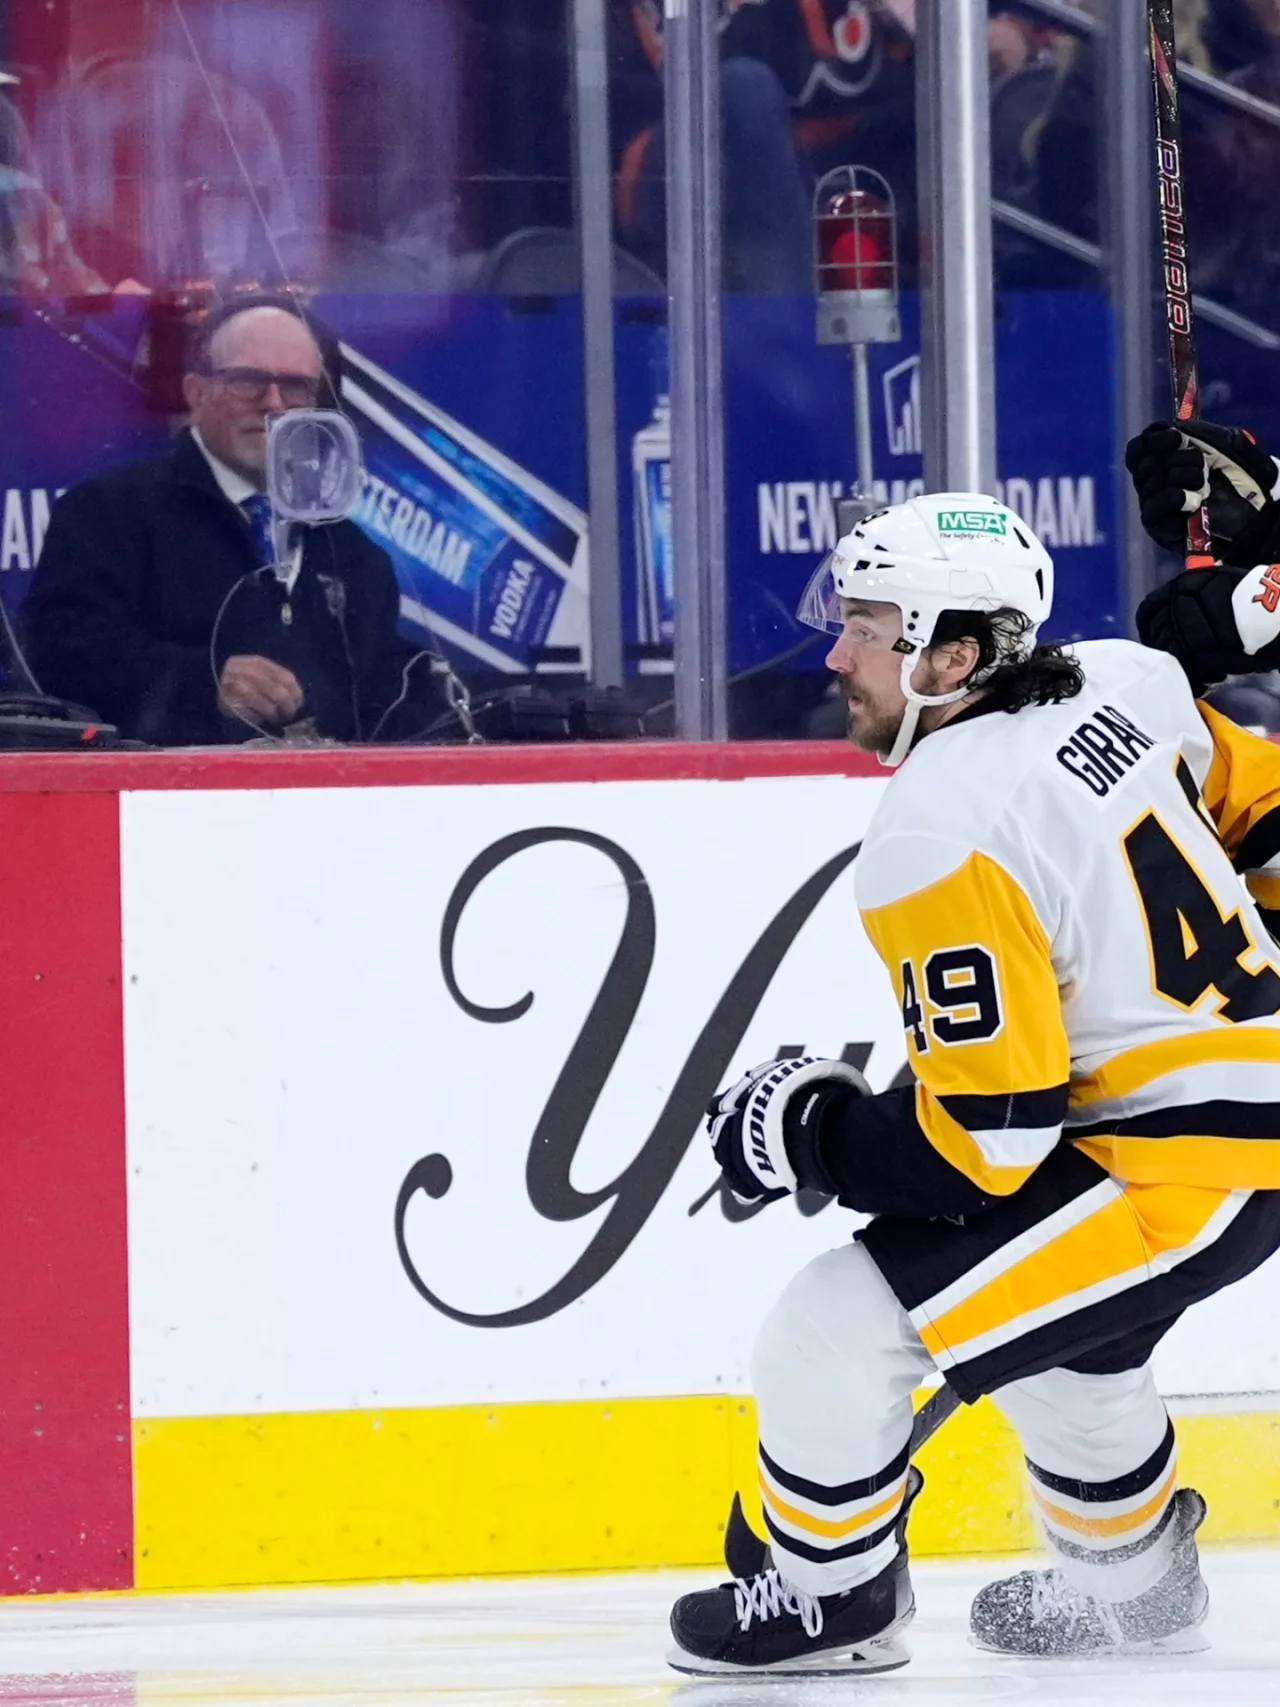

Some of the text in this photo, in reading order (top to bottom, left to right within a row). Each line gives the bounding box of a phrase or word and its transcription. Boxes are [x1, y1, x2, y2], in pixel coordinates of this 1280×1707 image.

[941, 512, 1004, 533] MSA
[488, 557, 536, 639] VODKA
[902, 943, 1005, 1056] 49
